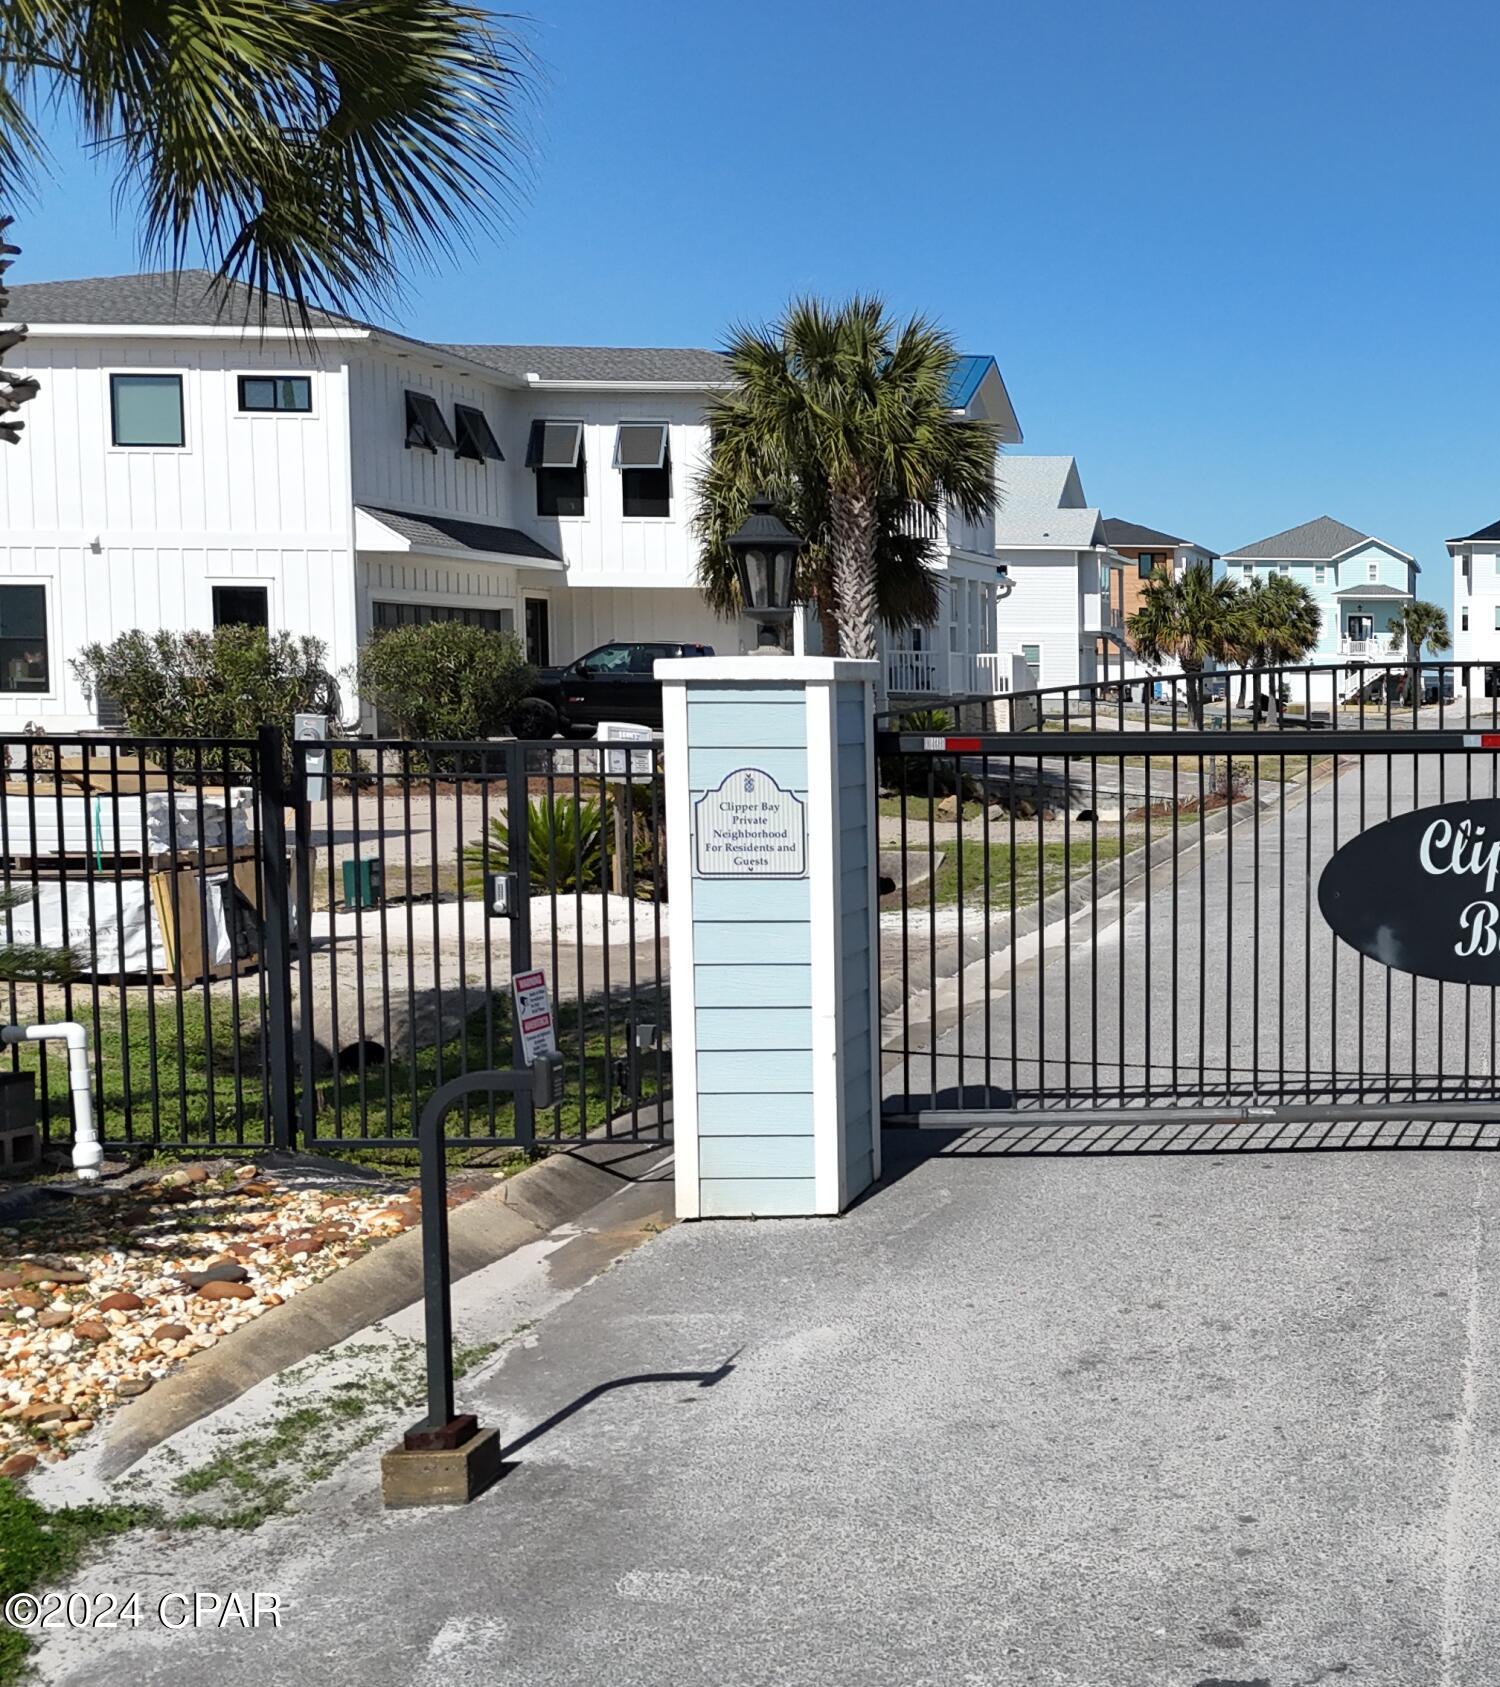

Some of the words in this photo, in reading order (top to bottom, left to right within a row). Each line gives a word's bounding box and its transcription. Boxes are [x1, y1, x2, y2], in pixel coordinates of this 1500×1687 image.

[719, 802, 758, 814] Clipper
[761, 802, 780, 814] Bay
[732, 816, 768, 825] Private
[713, 829, 787, 841] Neighborhood
[705, 844, 722, 852] For
[725, 843, 775, 852] Residents
[777, 843, 796, 852] and
[733, 857, 769, 866] Guests
